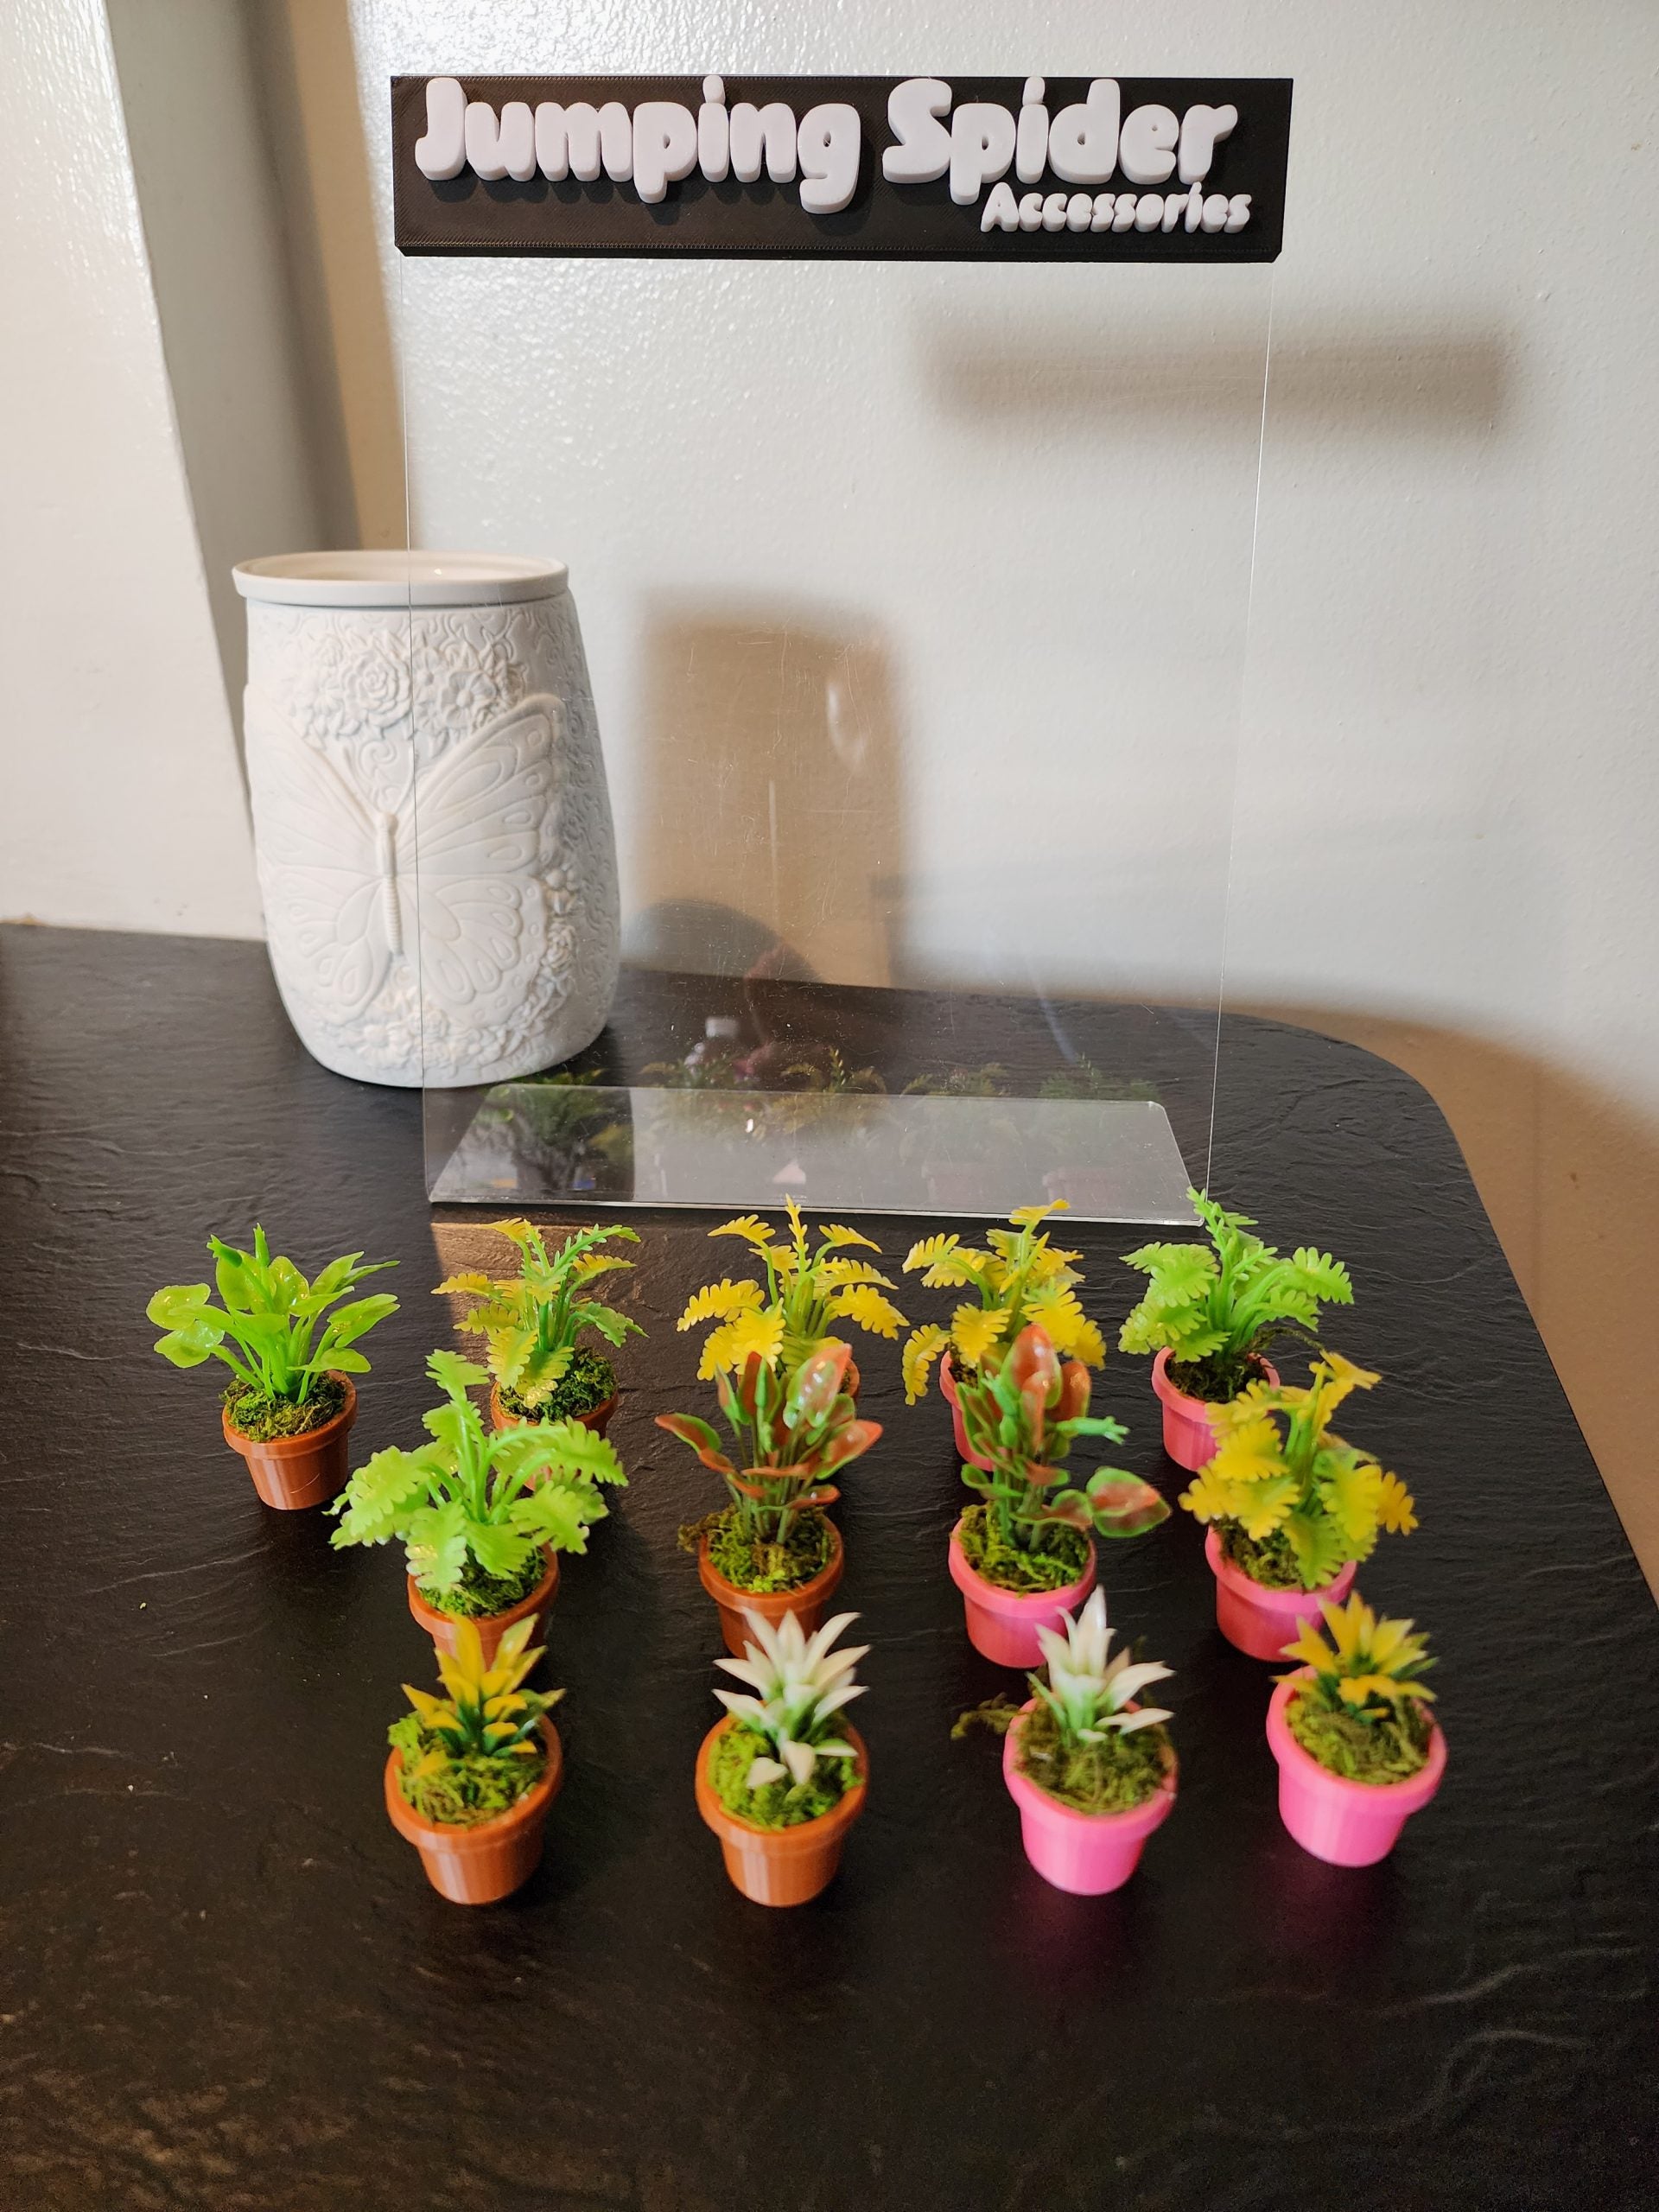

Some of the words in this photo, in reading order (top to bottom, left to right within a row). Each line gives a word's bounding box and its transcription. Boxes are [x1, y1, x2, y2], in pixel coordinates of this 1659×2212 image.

[415, 76, 861, 214] Jumping
[881, 78, 1239, 205] Spider
[980, 181, 1252, 232] Accessories
